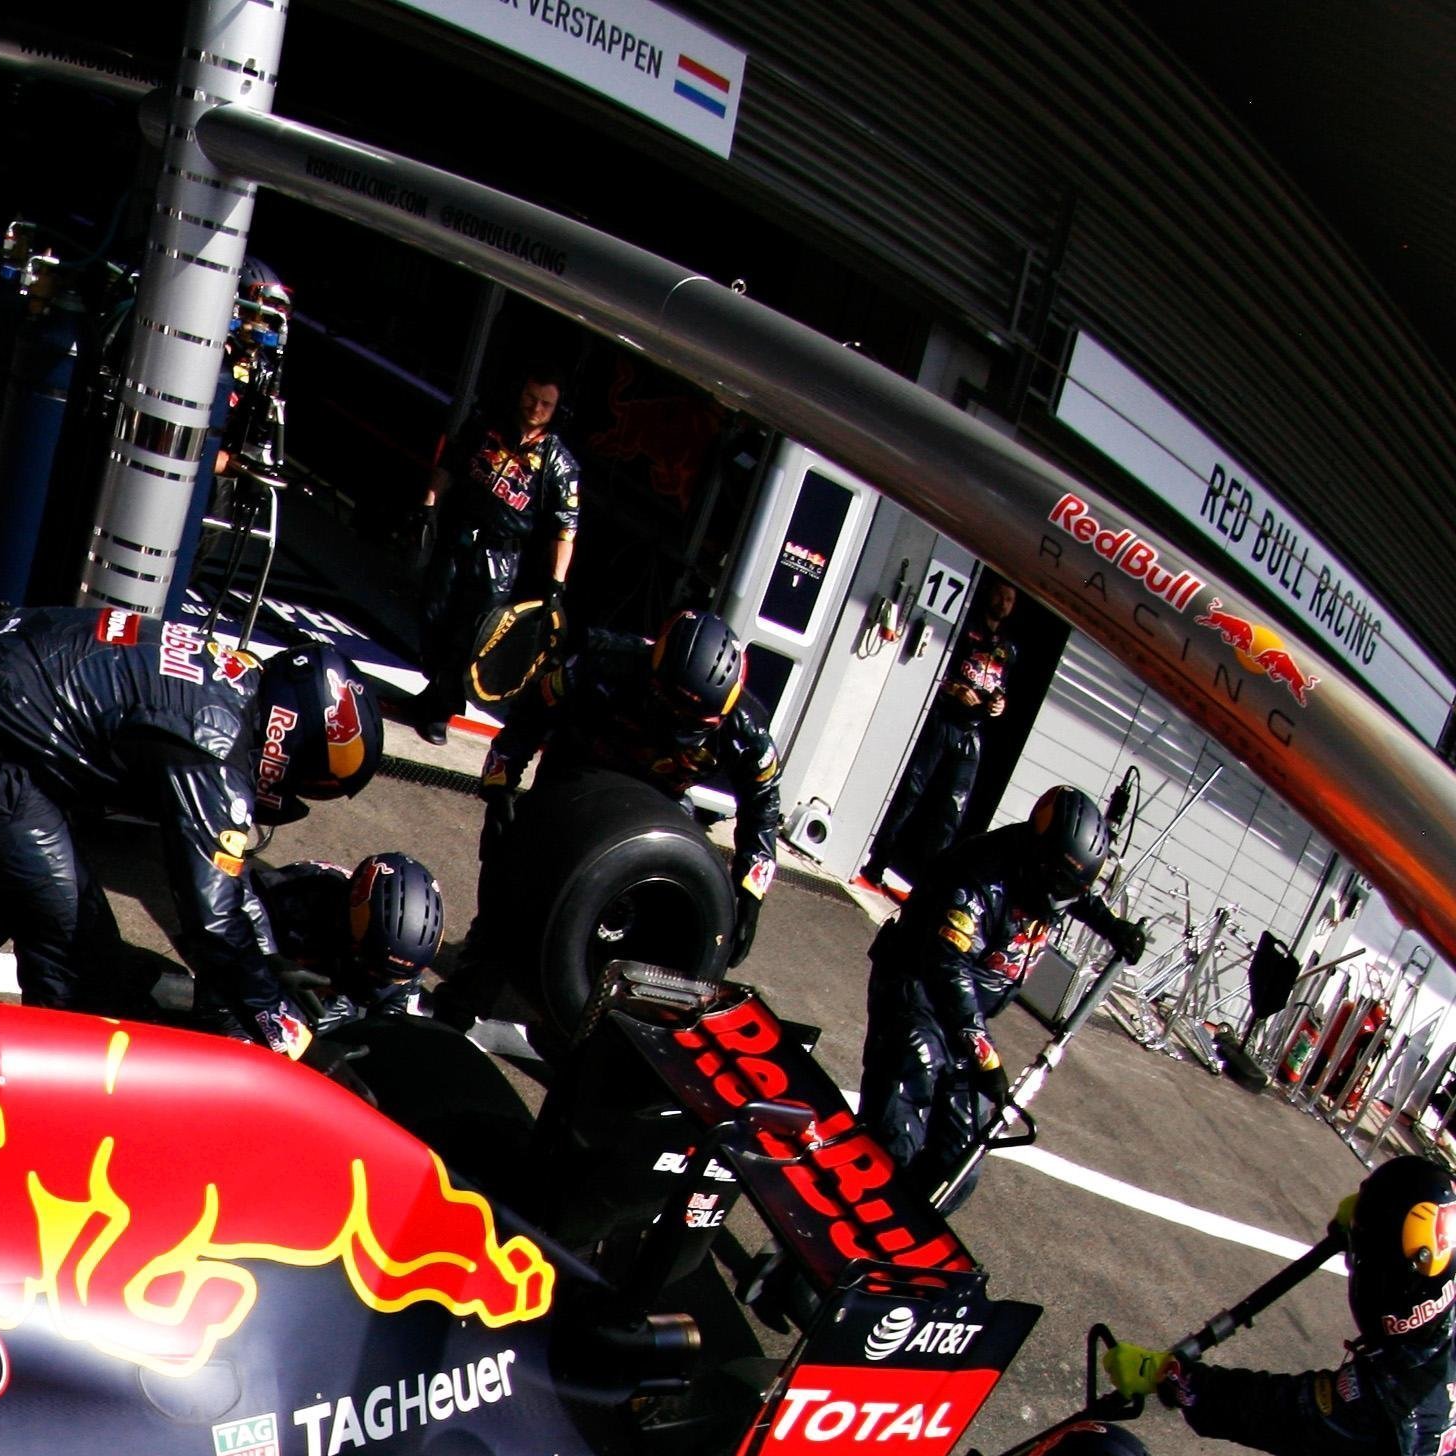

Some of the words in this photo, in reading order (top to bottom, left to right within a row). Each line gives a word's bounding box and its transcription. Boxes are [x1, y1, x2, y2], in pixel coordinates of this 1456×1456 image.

[305, 155, 429, 219] REDBULLRACING.COM
[438, 206, 567, 276] @REDBULLRACING
[1200, 464, 1249, 543] RED
[1253, 510, 1316, 600] BULL
[1308, 563, 1383, 667] RACING
[926, 570, 965, 615] 17
[905, 1321, 984, 1355] AT&T
[219, 1419, 272, 1448] TAG
[774, 1387, 952, 1441] TOTAL
